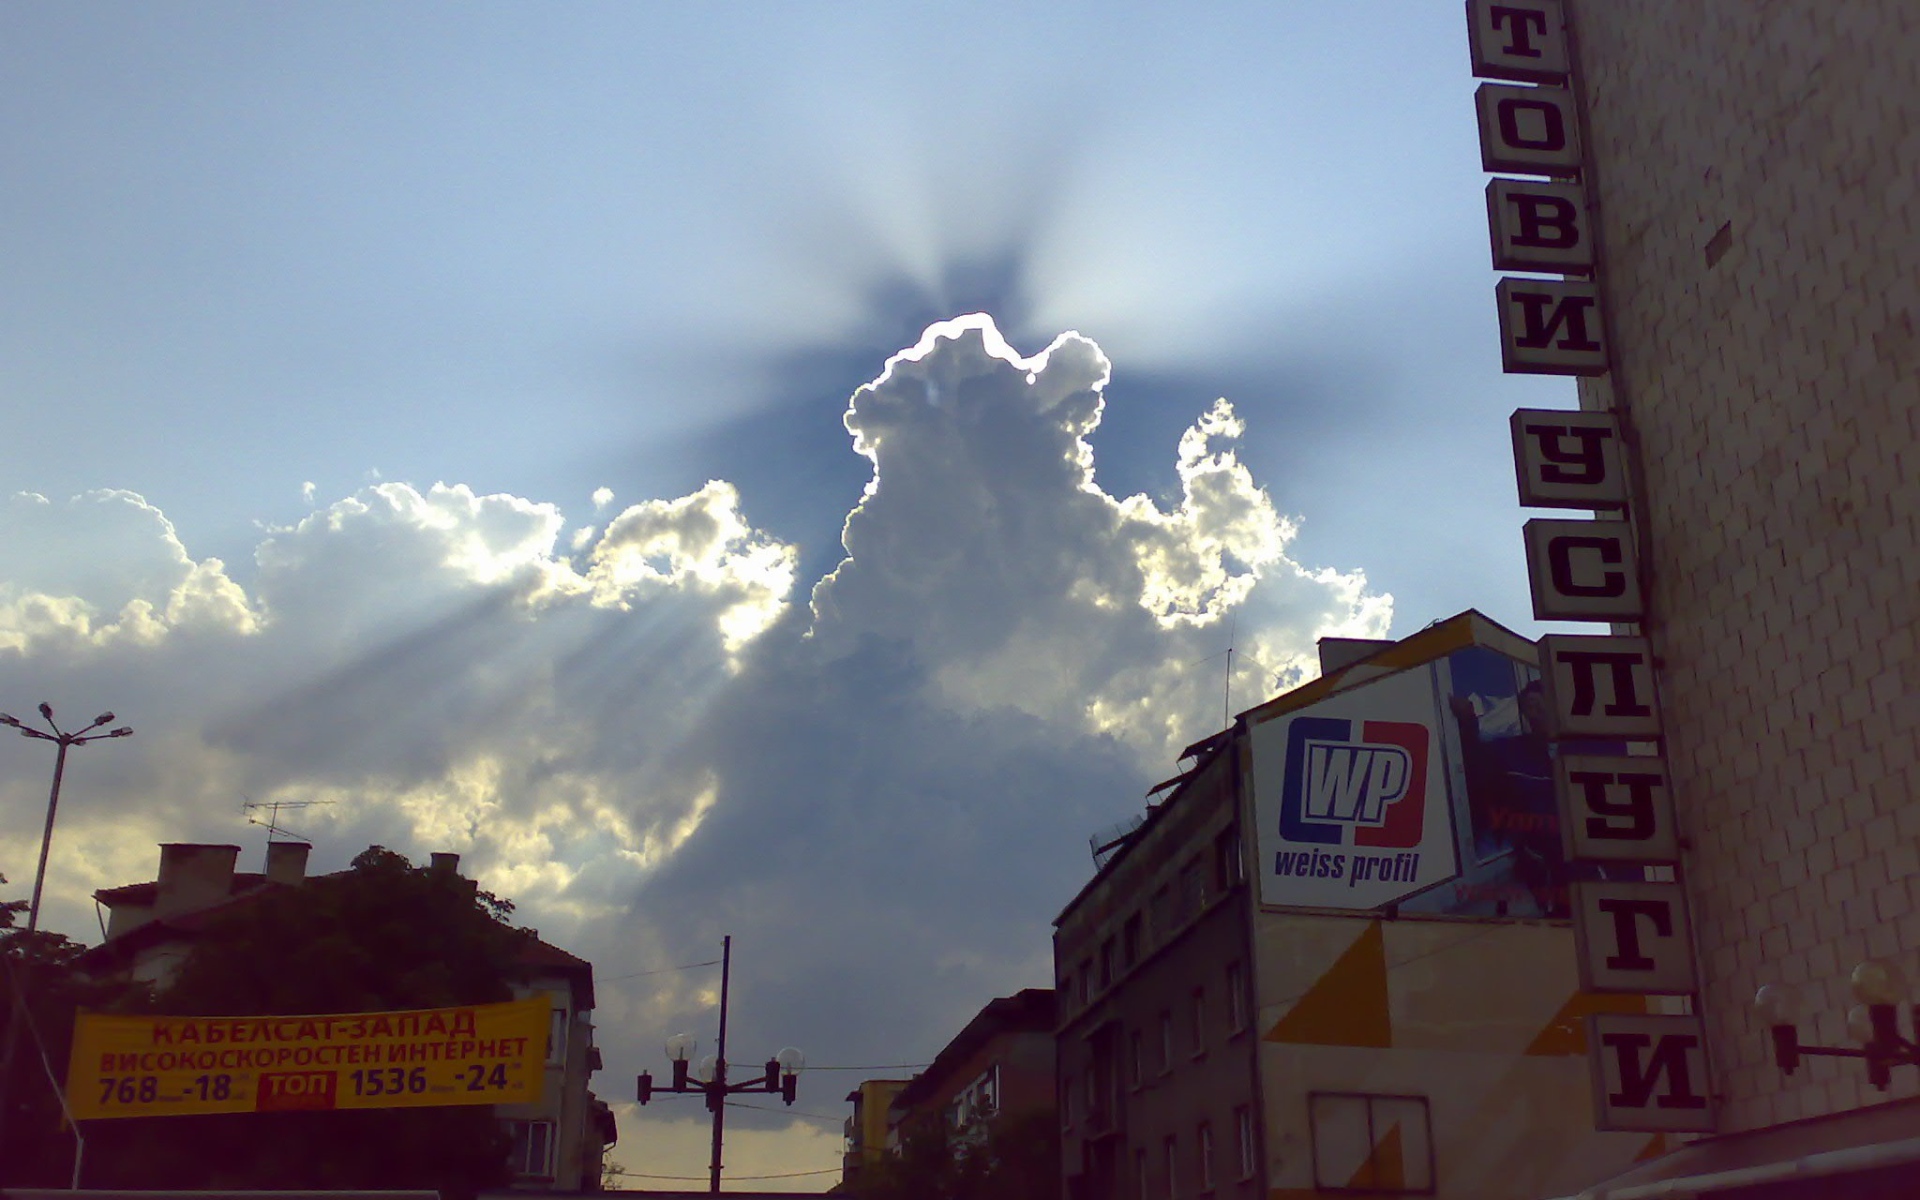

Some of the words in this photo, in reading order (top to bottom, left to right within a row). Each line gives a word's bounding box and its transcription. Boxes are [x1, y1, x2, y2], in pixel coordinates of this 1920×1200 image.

[1489, 5, 1601, 352] ТОВИ
[1302, 741, 1410, 825] WP
[1525, 424, 1706, 1109] УСЛУГИ
[1274, 848, 1346, 879] weiss
[1350, 853, 1420, 888] profil
[152, 1010, 477, 1045] КАБЕЛСАТ-ЗАПАД
[100, 1044, 381, 1072] ВИСОКОСКОРОСТЕН
[387, 1037, 528, 1063] ИНТЕРНЕТ
[99, 1075, 158, 1103] 768
[268, 1074, 328, 1096] ТОП
[350, 1066, 427, 1096] 1536
